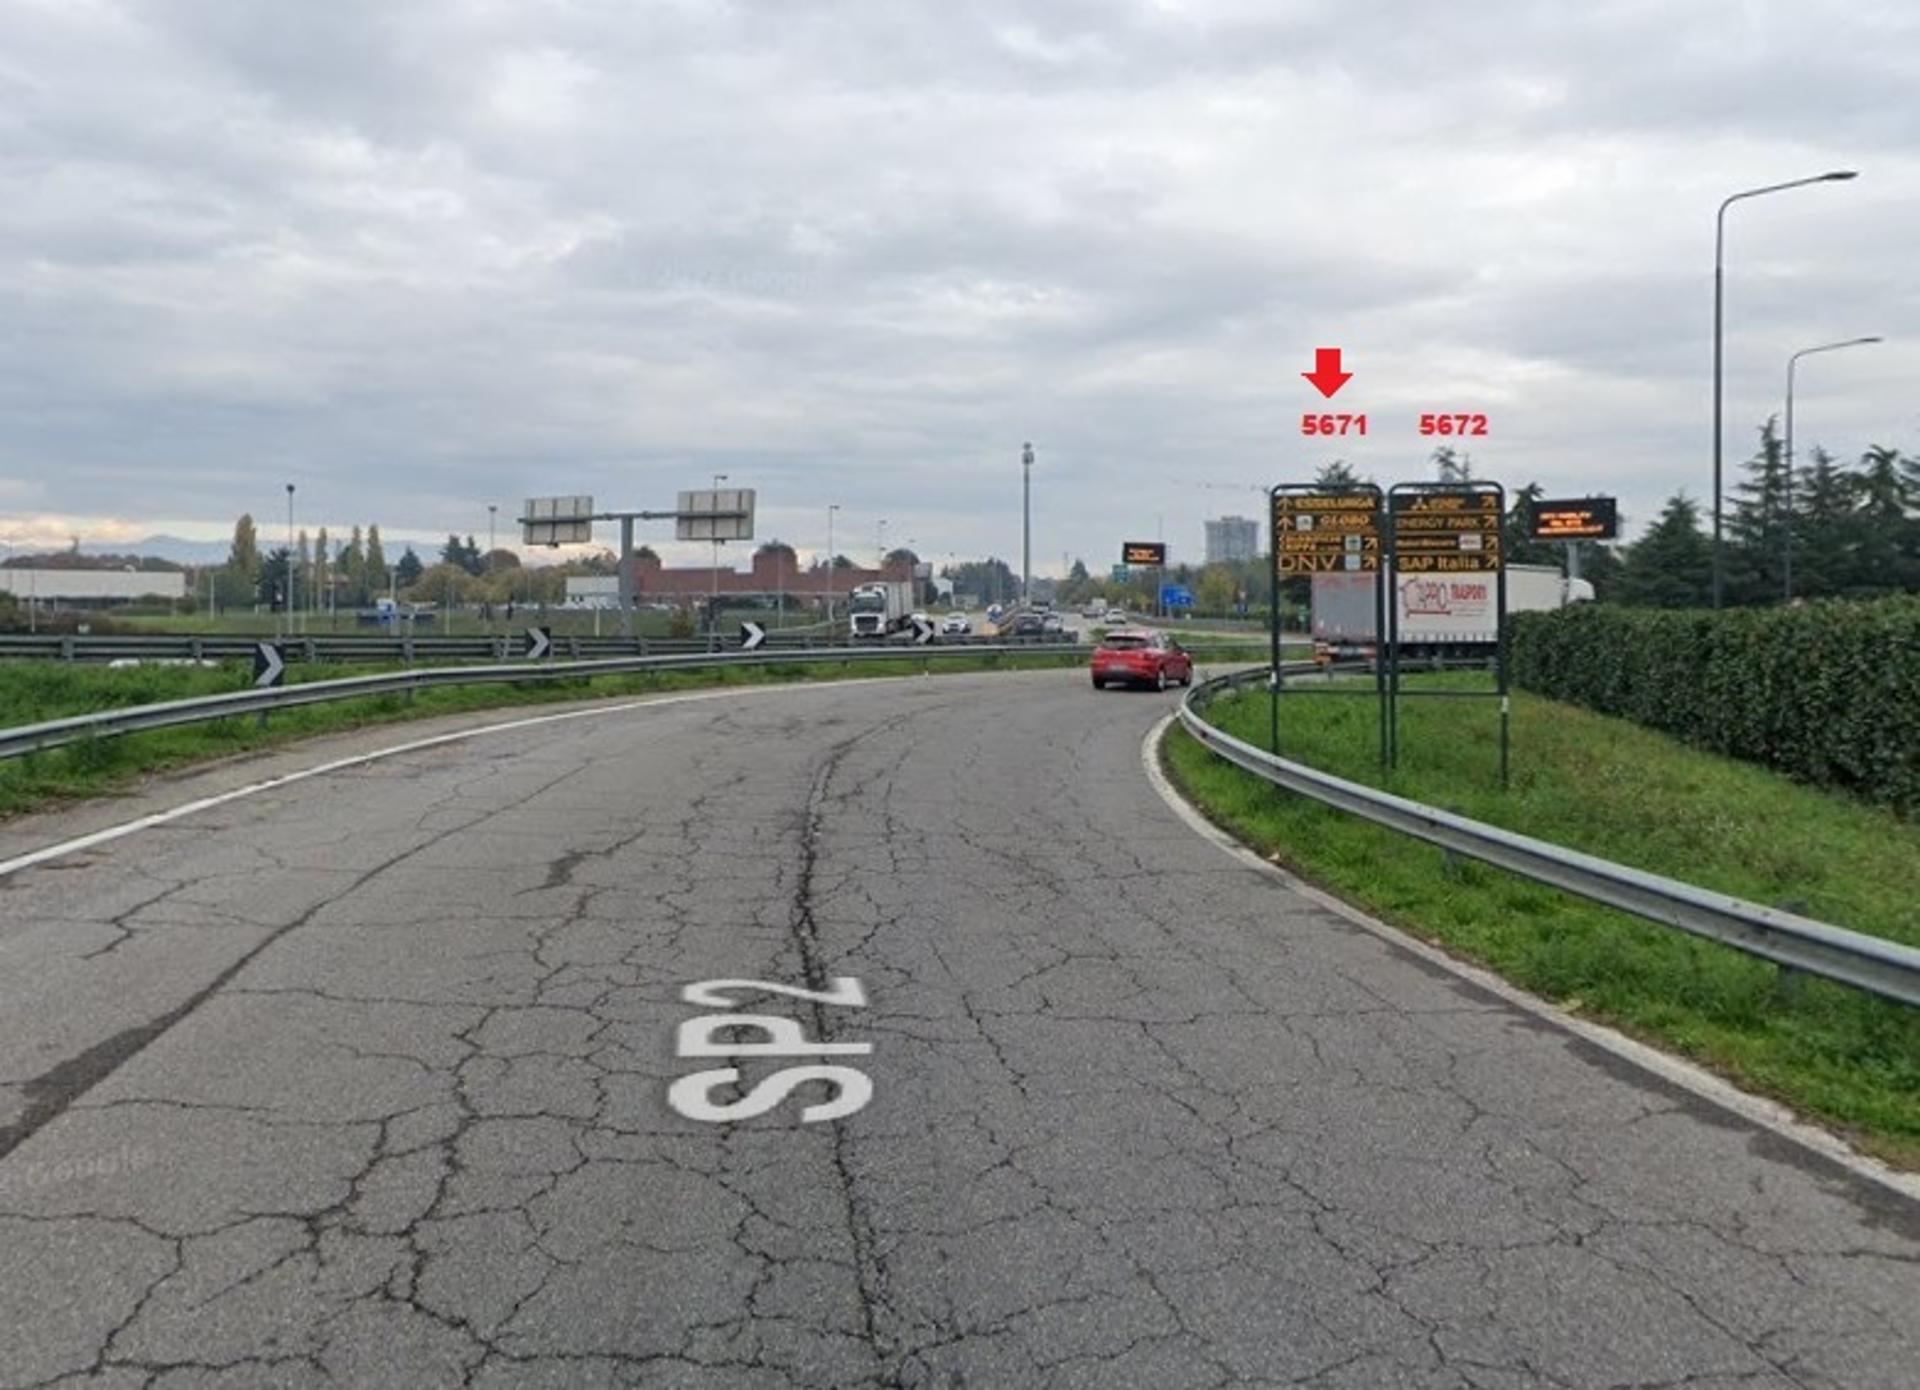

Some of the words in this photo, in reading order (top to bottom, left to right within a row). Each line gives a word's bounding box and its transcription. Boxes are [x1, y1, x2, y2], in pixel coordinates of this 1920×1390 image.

[1395, 517, 1445, 529] ENERGY
[1447, 517, 1480, 528] PARK
[1278, 555, 1337, 571] DNV
[1398, 556, 1434, 570] SAP
[1437, 555, 1479, 570] Italia
[667, 976, 874, 1123] SP2
